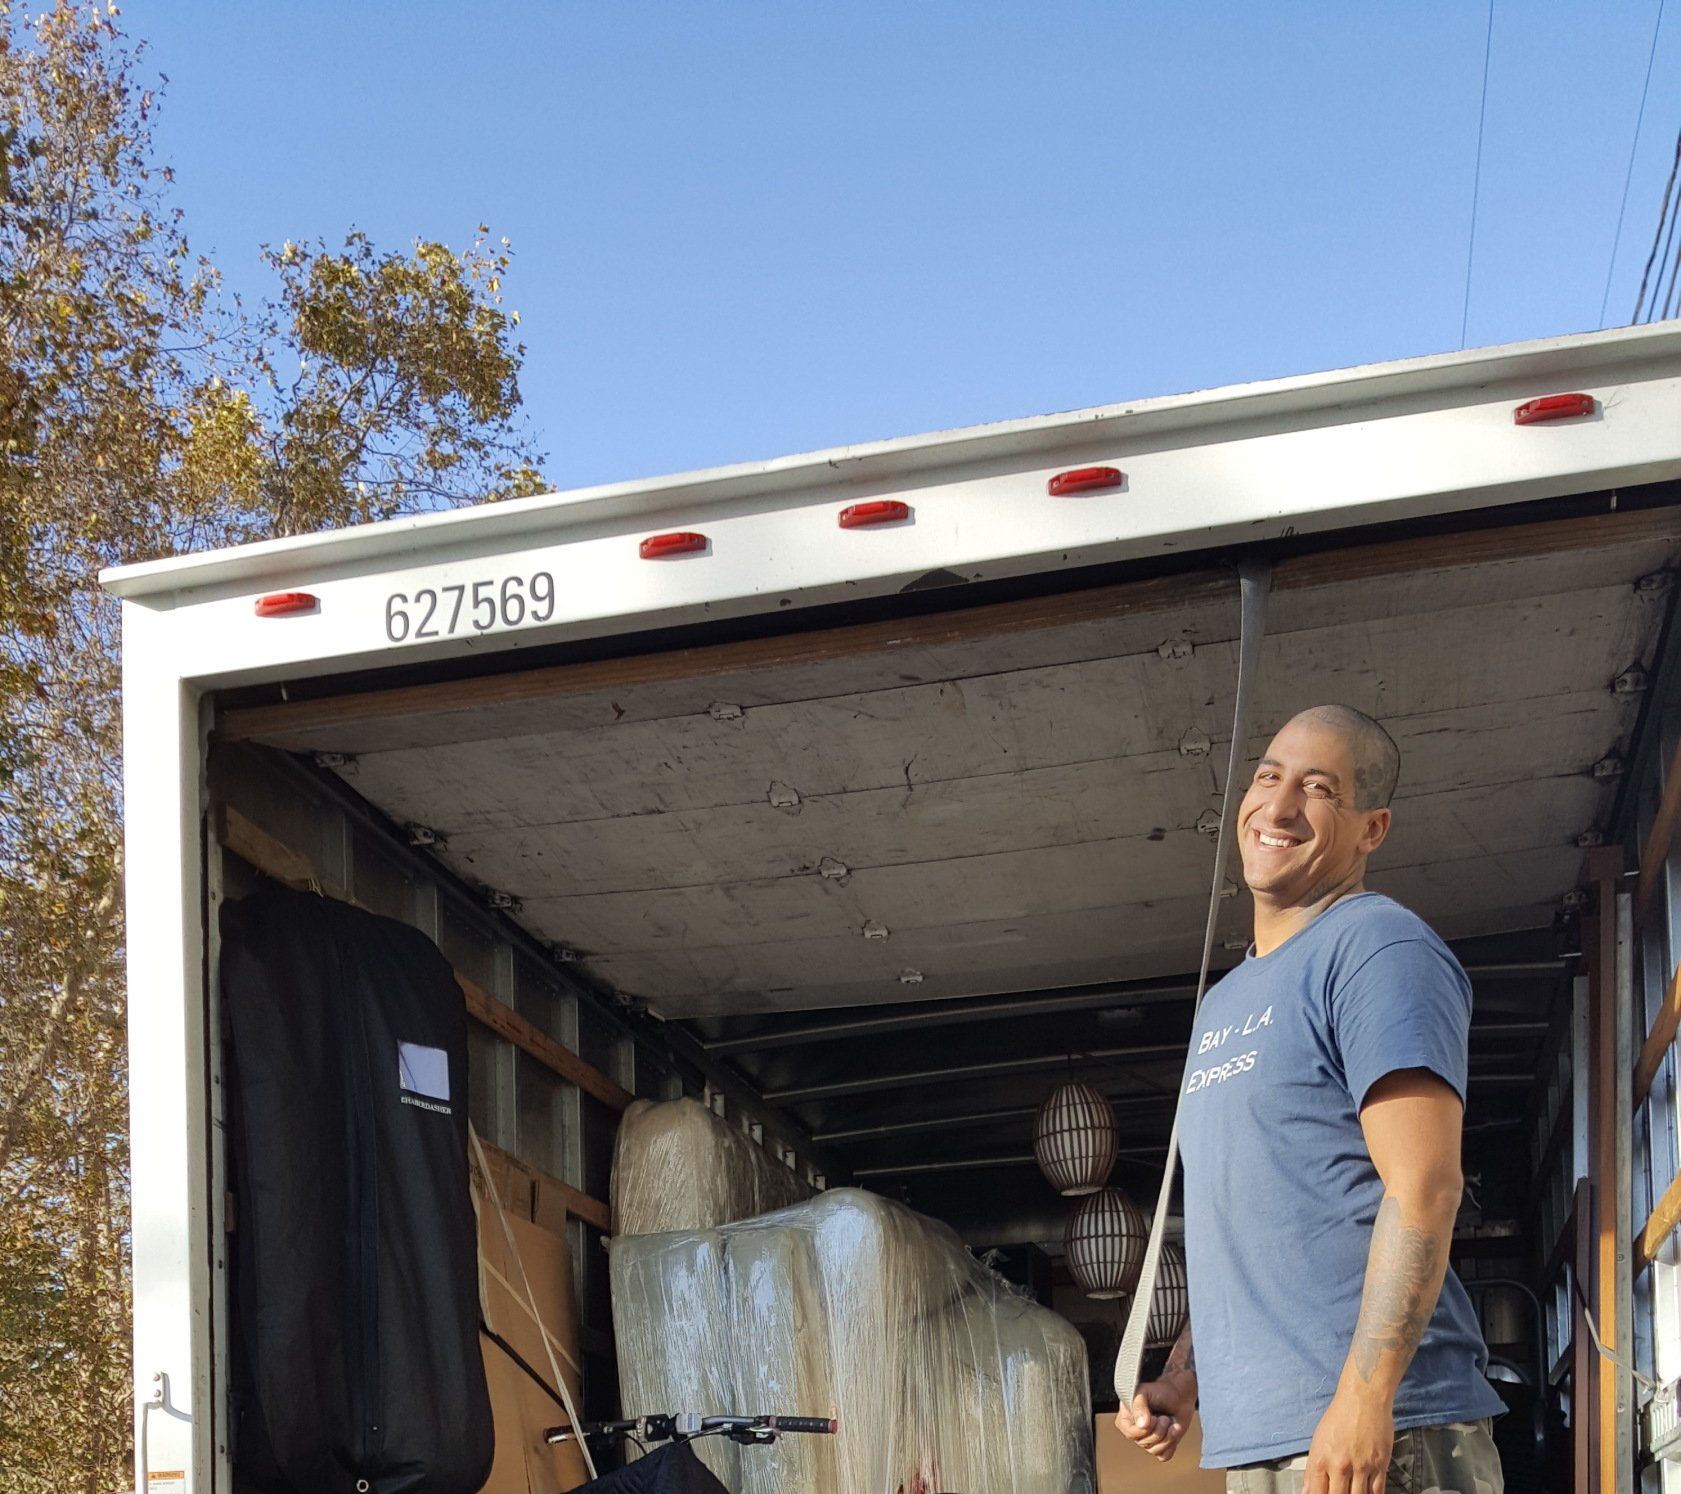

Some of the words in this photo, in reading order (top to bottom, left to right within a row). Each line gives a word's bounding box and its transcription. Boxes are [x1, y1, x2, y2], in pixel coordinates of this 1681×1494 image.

[385, 571, 555, 642] 627569
[1197, 1025, 1232, 1055] BAY
[1186, 1050, 1258, 1094] EXPRESS
